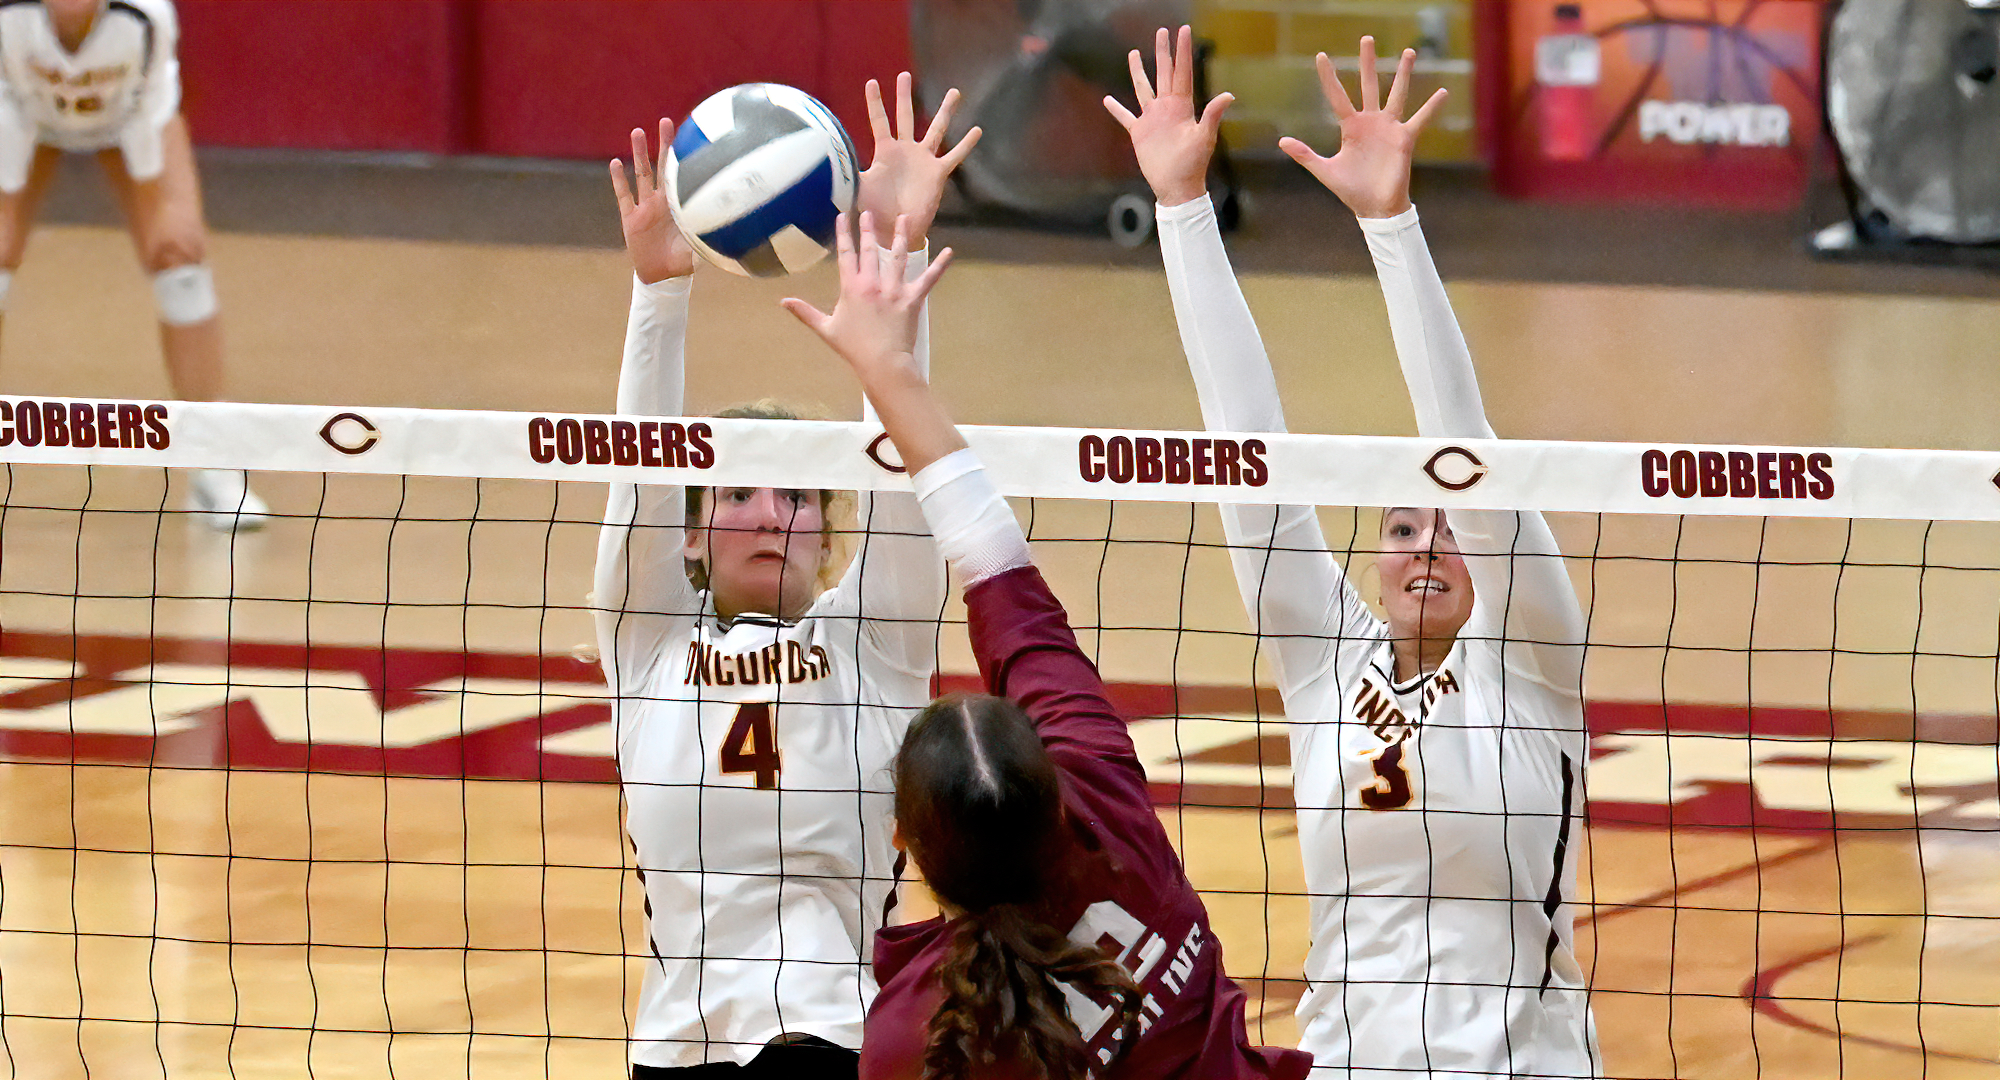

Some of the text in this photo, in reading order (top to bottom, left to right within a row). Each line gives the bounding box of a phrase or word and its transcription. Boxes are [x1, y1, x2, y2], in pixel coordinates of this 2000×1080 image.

[1637, 99, 1789, 146] POWER
[528, 417, 716, 469] COBBERS
[1078, 434, 1269, 487] COBBERS
[1641, 449, 1835, 500] COBBERS
[718, 701, 782, 790] 4
